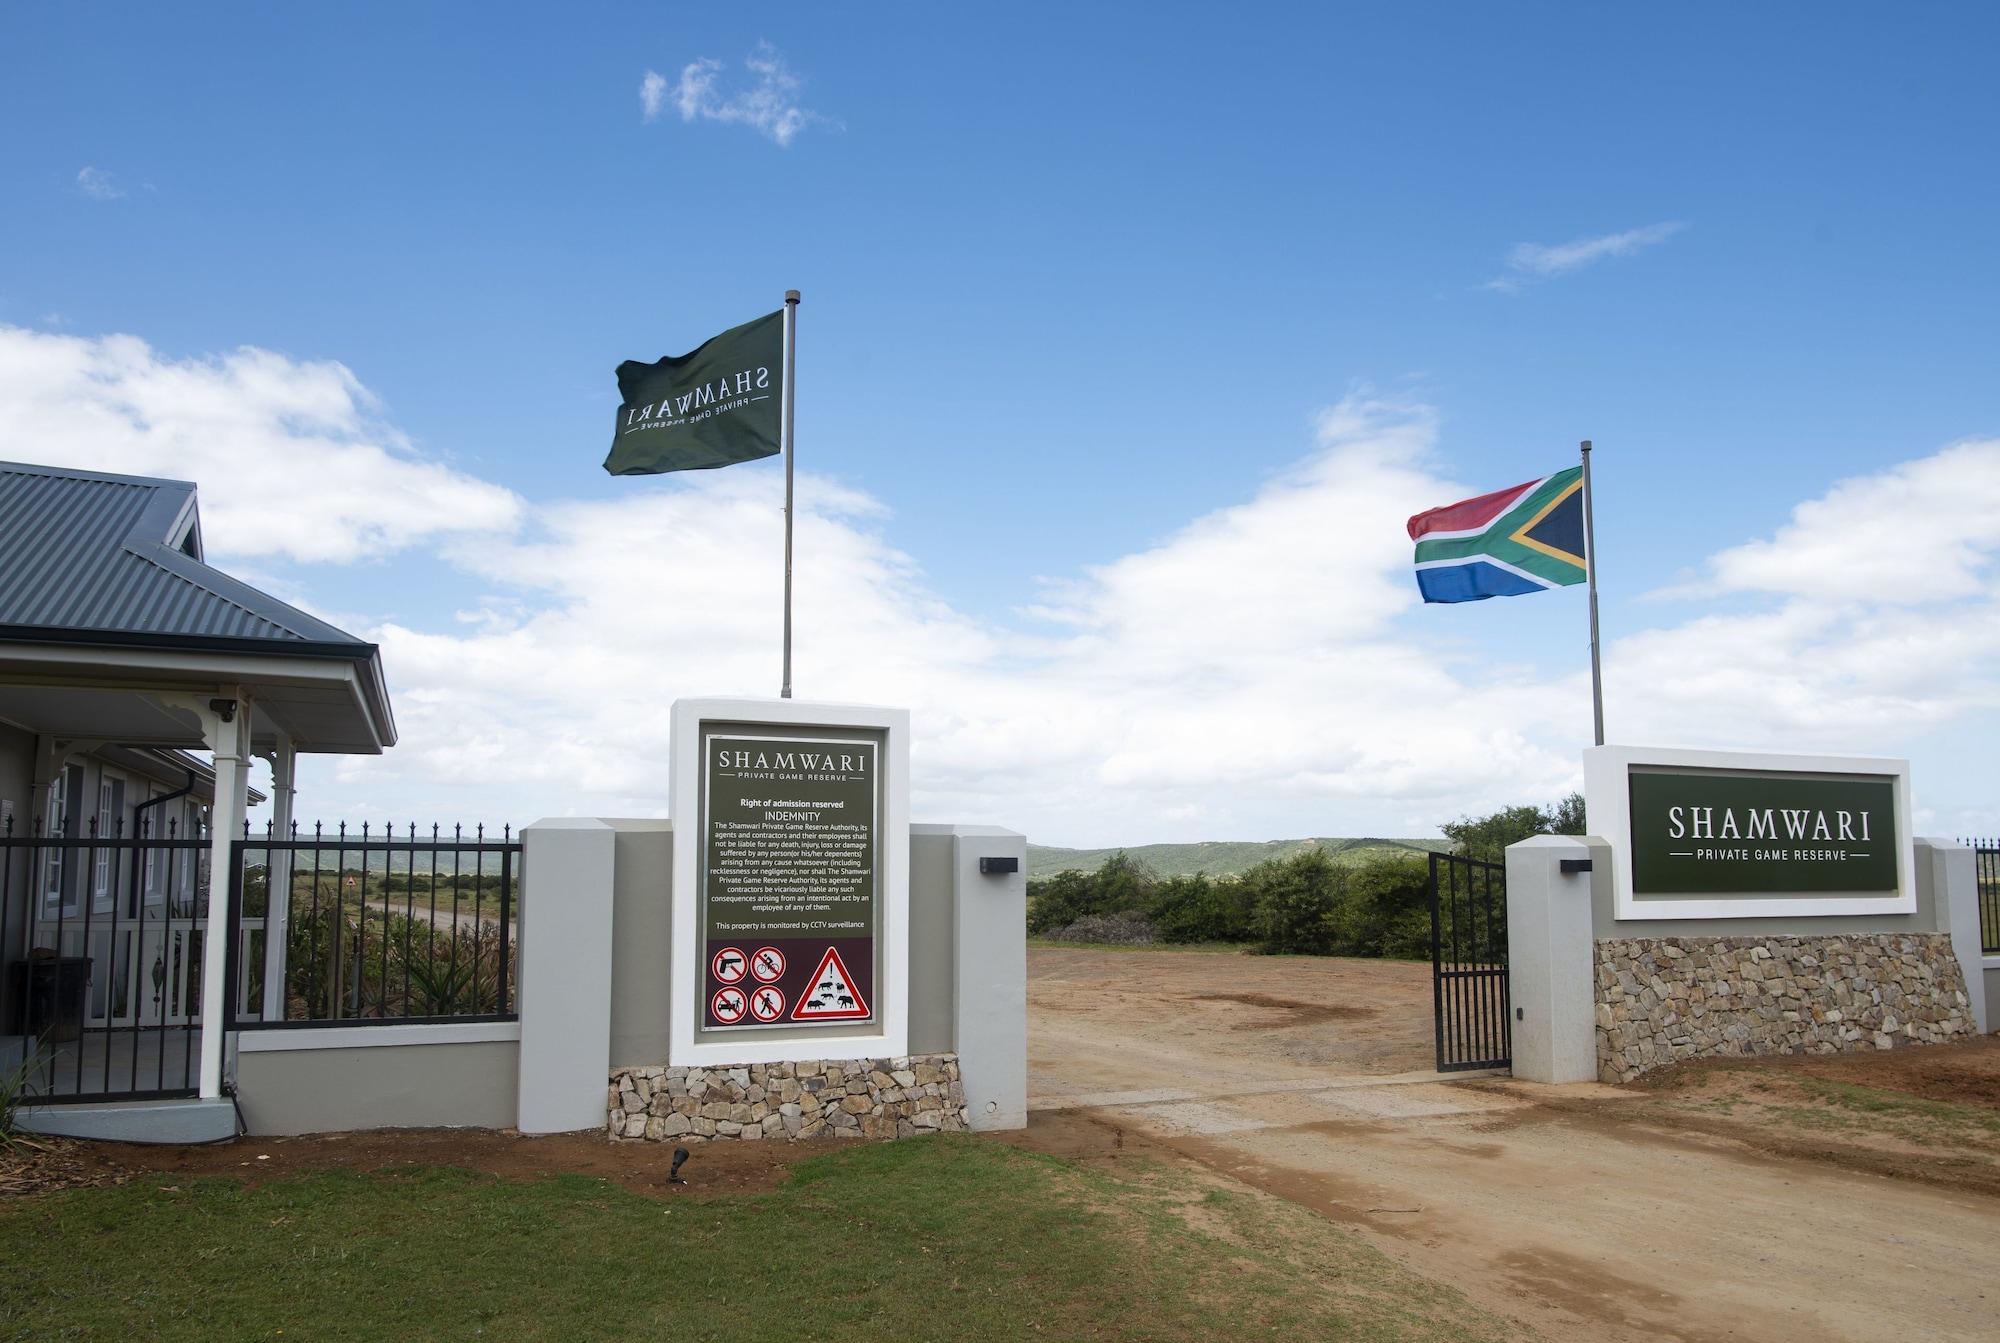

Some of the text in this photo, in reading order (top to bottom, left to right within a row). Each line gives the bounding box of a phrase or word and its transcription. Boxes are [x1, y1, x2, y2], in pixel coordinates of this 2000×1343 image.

[719, 751, 865, 772] SHAMWARI
[741, 799, 843, 809] Right of admission reserved
[765, 811, 820, 821] INDEMNITY
[1668, 806, 1870, 841] SHAMWARI
[830, 824, 859, 832] Authority,
[715, 832, 737, 840] agents
[818, 833, 851, 841] employees
[843, 842, 866, 850] damage
[748, 850, 755, 858] by
[770, 850, 799, 858] person(or
[825, 850, 862, 858] dependents)
[1698, 849, 1846, 861] PRIVATE GAME RESERVE
[721, 859, 743, 867] arising
[831, 859, 861, 867] (including
[760, 868, 798, 876] negligence),
[789, 877, 818, 885] Authority,
[775, 886, 807, 894] vicariously
[752, 904, 783, 912] employee
[732, 923, 759, 931] property
[802, 922, 809, 930] by
